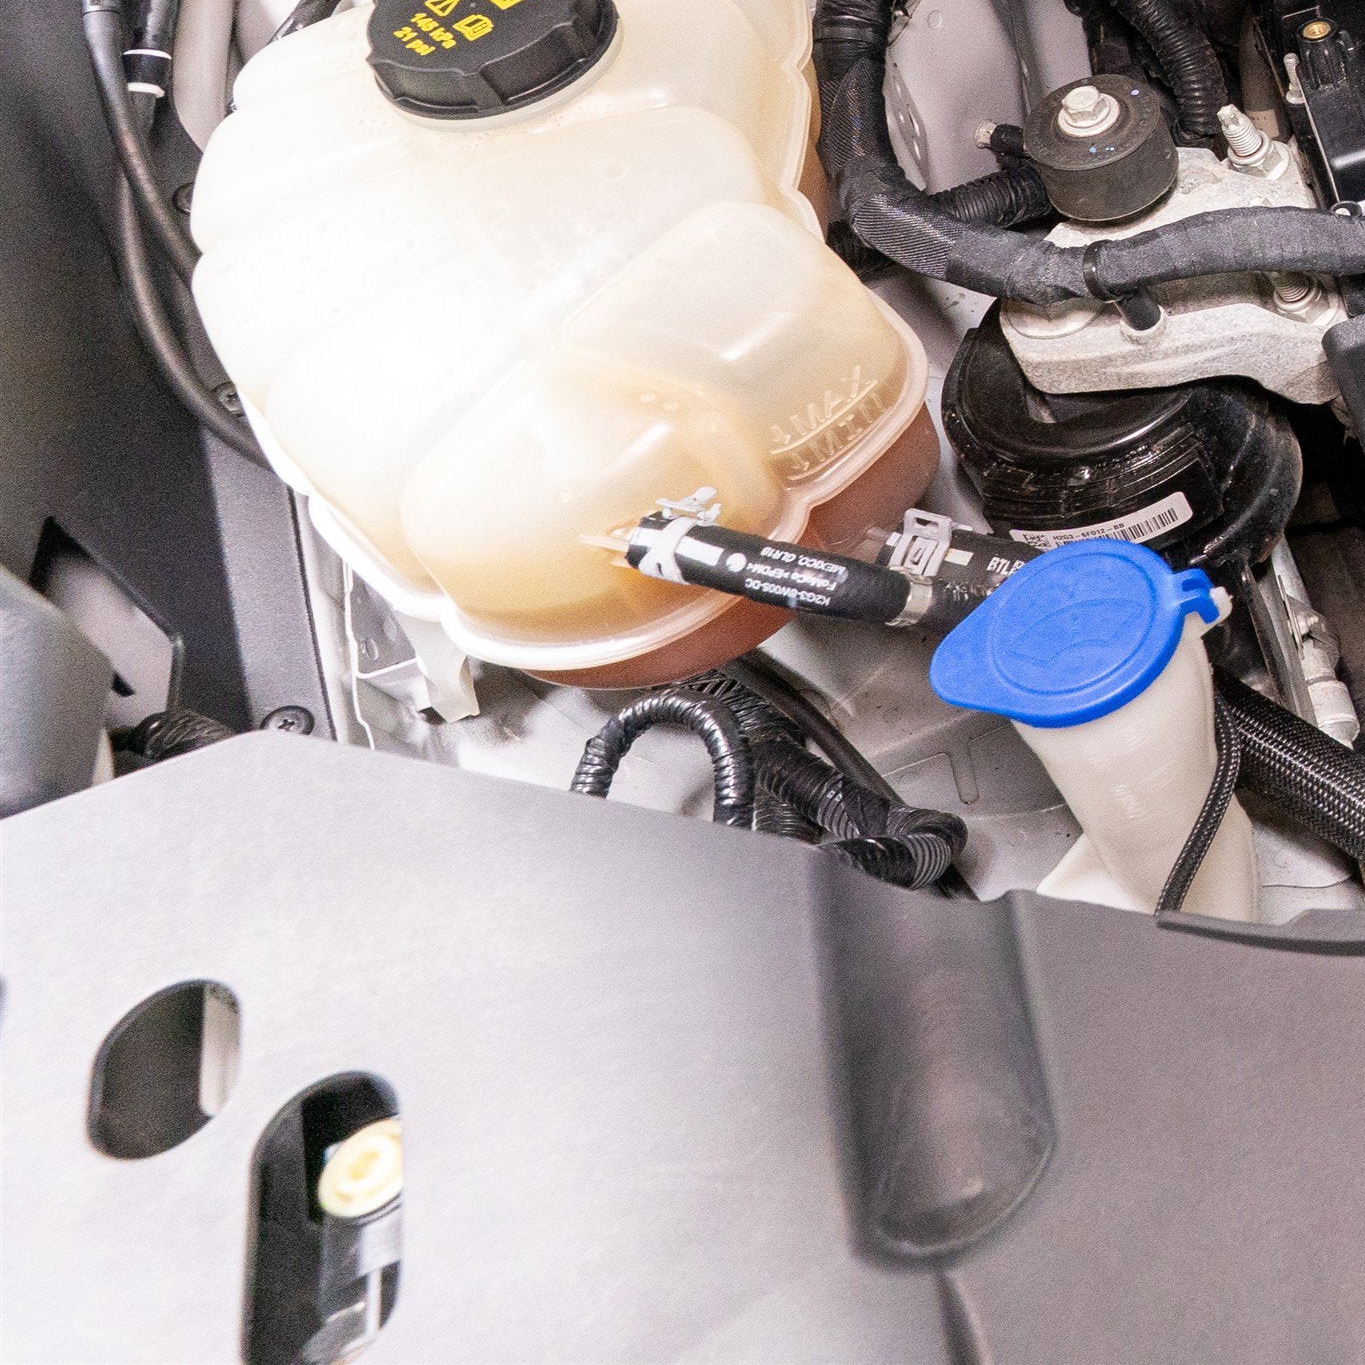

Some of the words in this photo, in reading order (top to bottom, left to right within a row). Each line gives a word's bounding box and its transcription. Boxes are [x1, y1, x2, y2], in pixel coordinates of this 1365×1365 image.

[393, 26, 418, 42] 21
[787, 365, 877, 436] MAX
[808, 391, 889, 463] MIN
